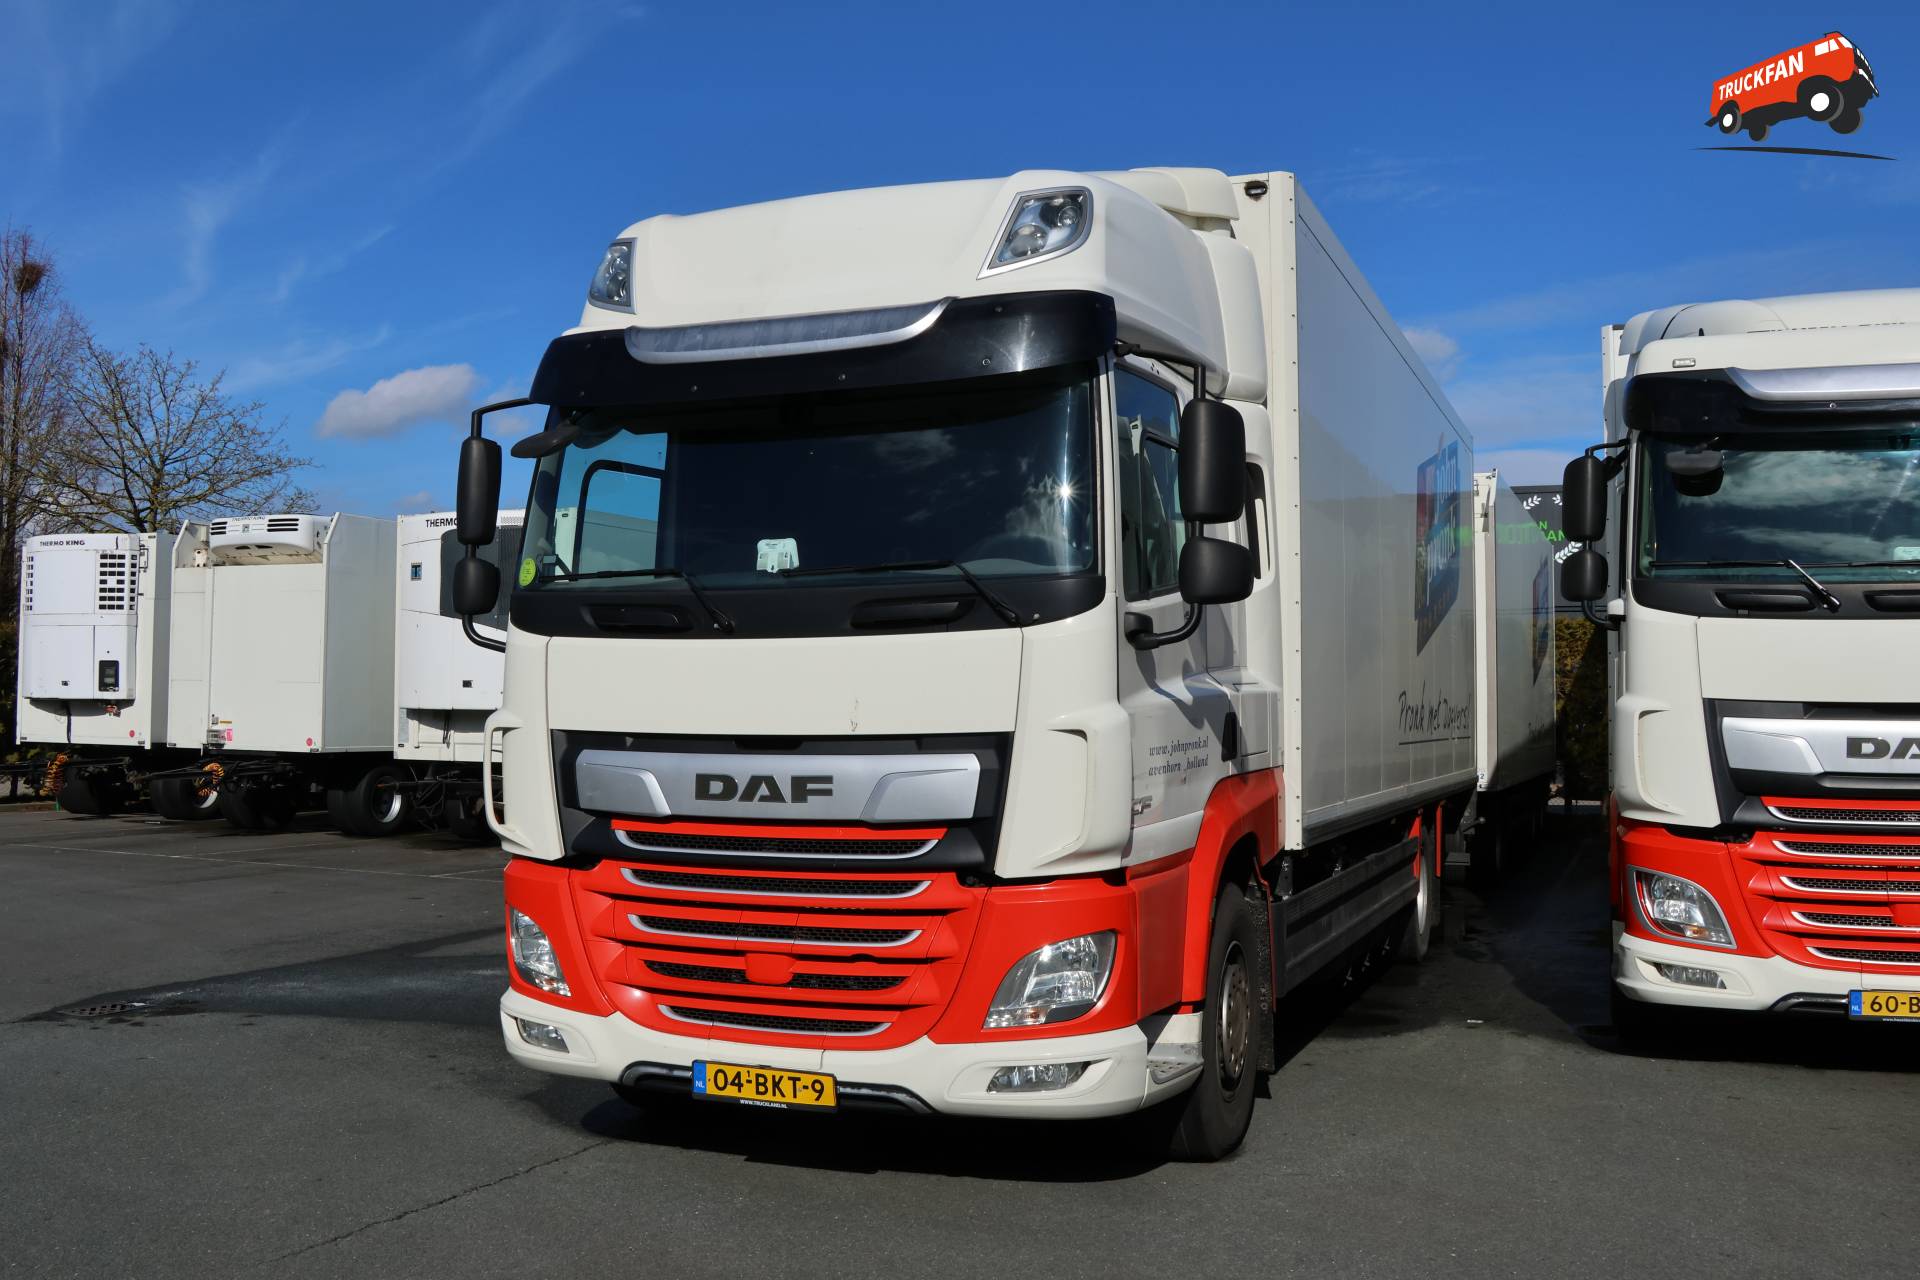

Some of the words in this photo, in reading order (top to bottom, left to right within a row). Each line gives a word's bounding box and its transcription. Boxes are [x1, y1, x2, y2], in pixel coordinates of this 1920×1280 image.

[1149, 735, 1209, 757] www.johnpronk.nl
[695, 773, 834, 804] DAF
[1851, 1004, 1861, 1012] NL
[695, 1080, 706, 1089] NL
[713, 1068, 825, 1102] 04-BKT-9
